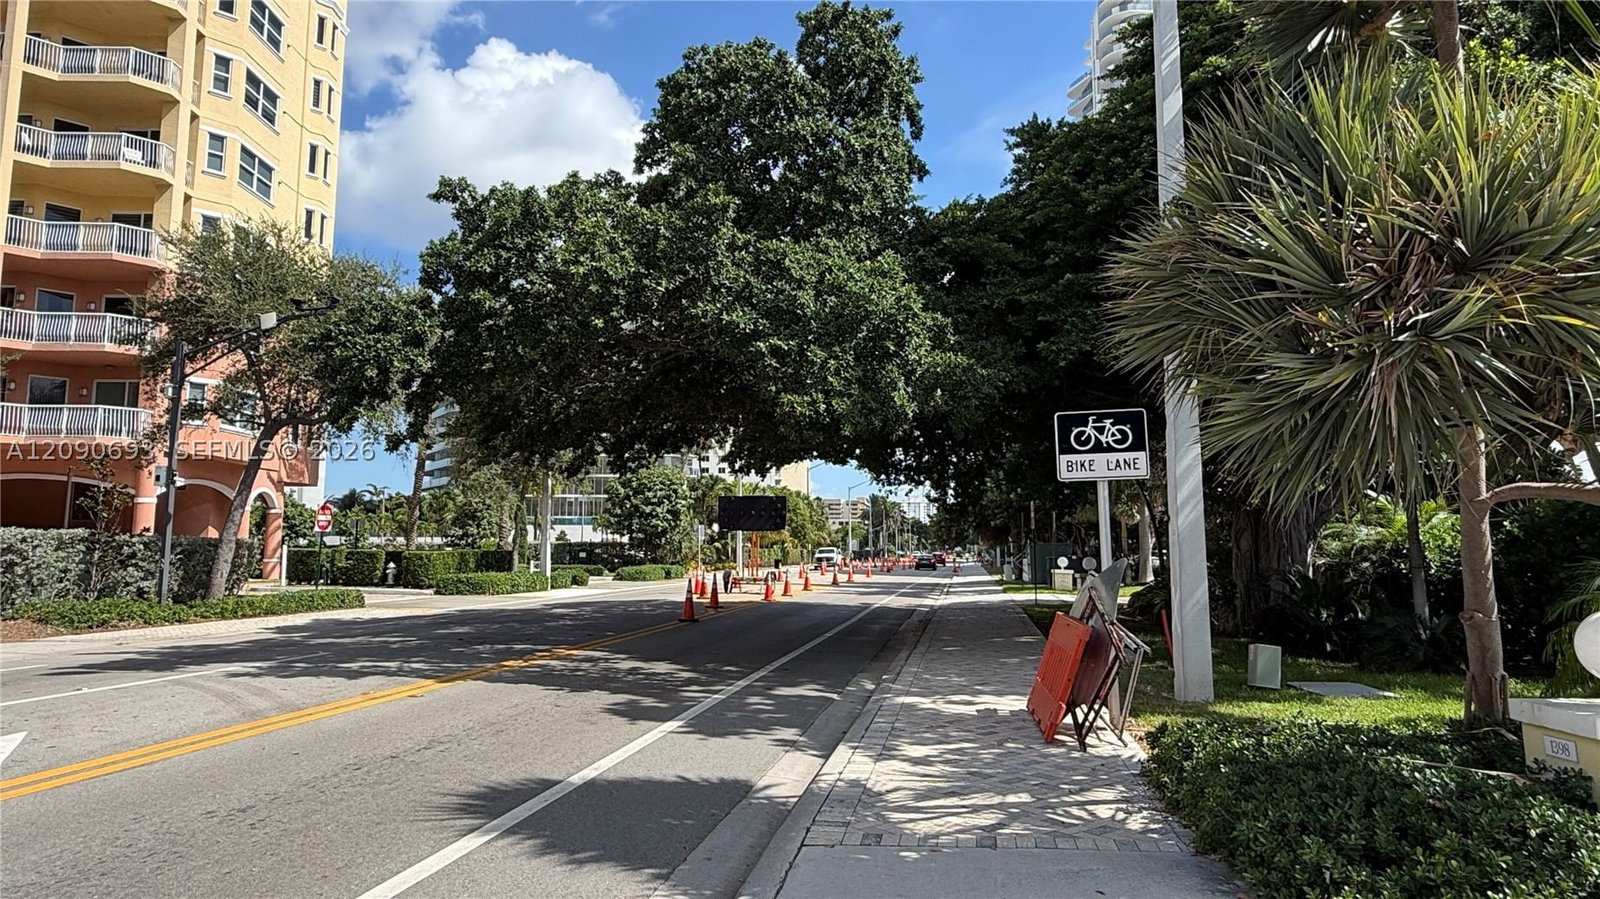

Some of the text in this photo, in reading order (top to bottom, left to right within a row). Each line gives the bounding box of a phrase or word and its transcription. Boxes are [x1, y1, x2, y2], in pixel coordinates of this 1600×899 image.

[1066, 457, 1141, 473] BIKE LANE
[1550, 740, 1571, 757] 1398
